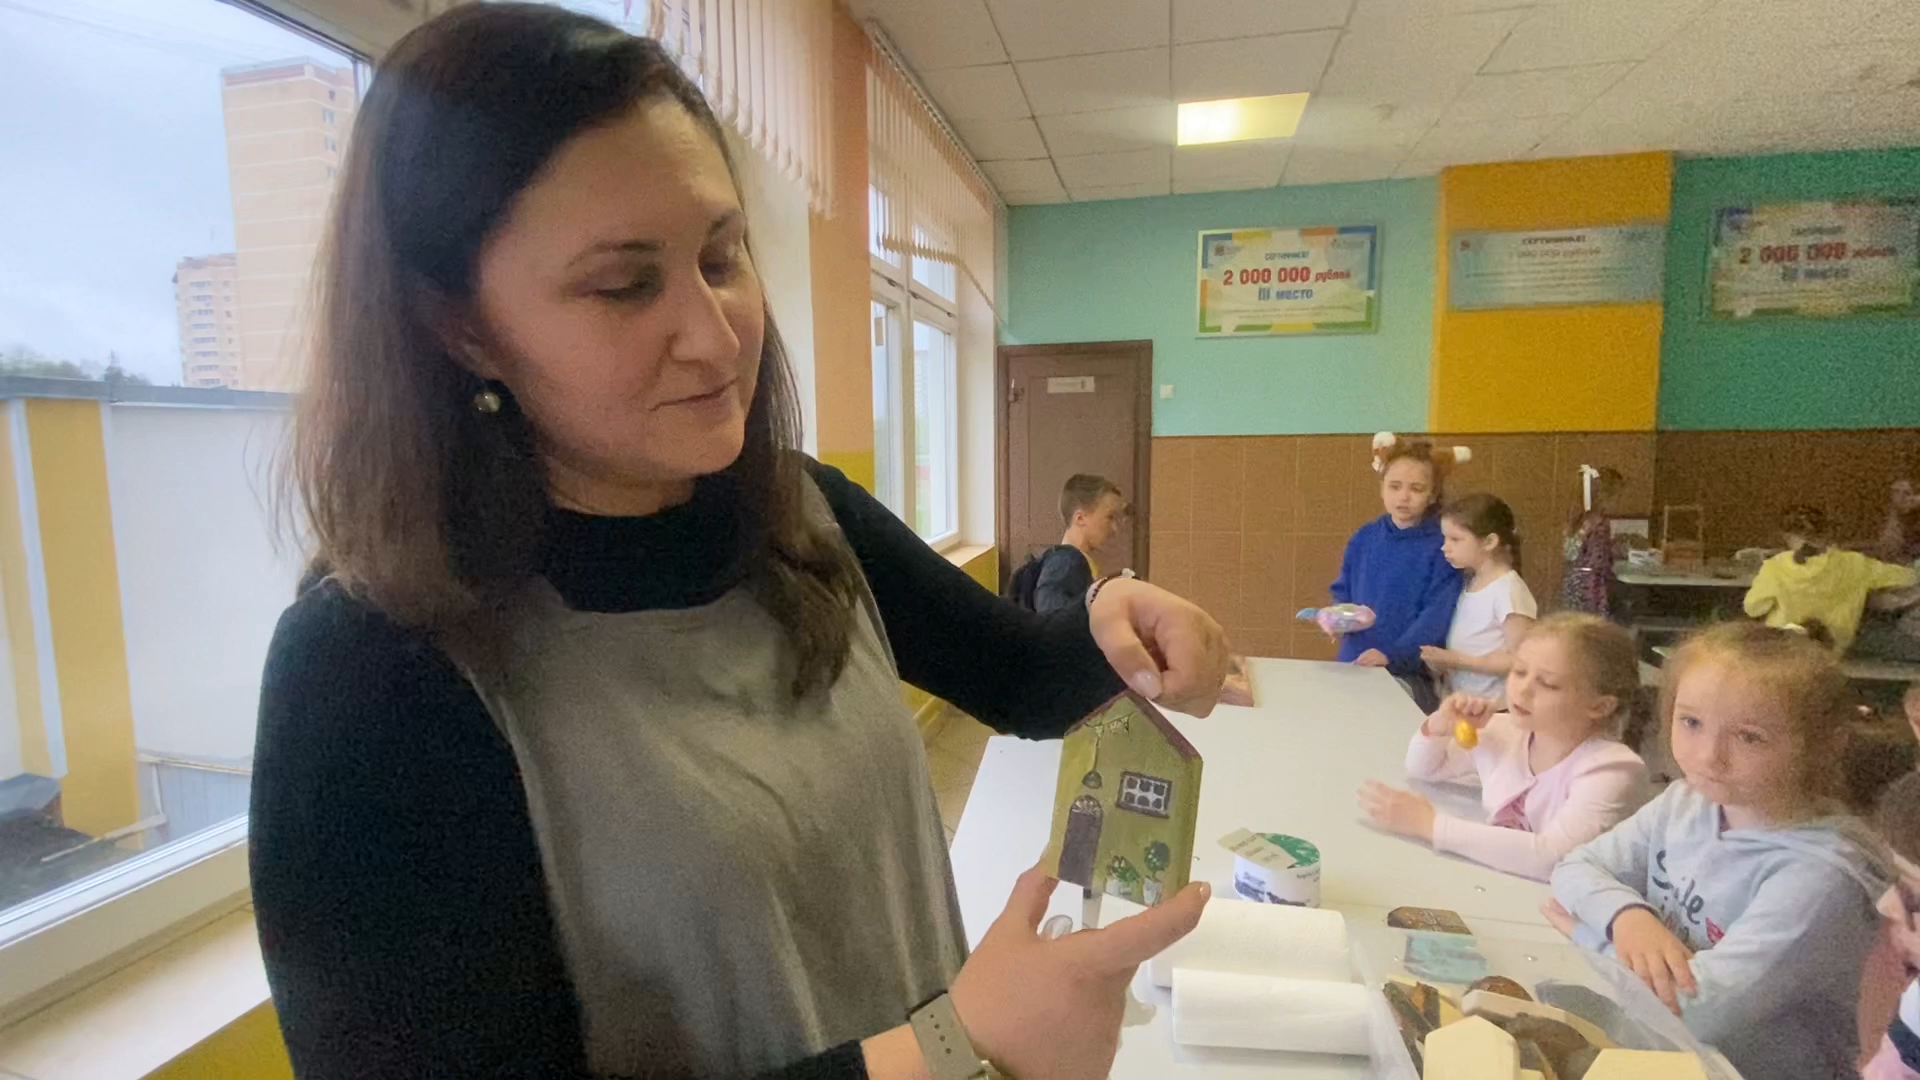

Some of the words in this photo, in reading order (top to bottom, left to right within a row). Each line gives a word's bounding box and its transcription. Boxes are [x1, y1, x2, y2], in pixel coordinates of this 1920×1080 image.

[1223, 269, 1234, 286] 2
[1239, 268, 1272, 285] 000
[1278, 266, 1311, 283] 000
